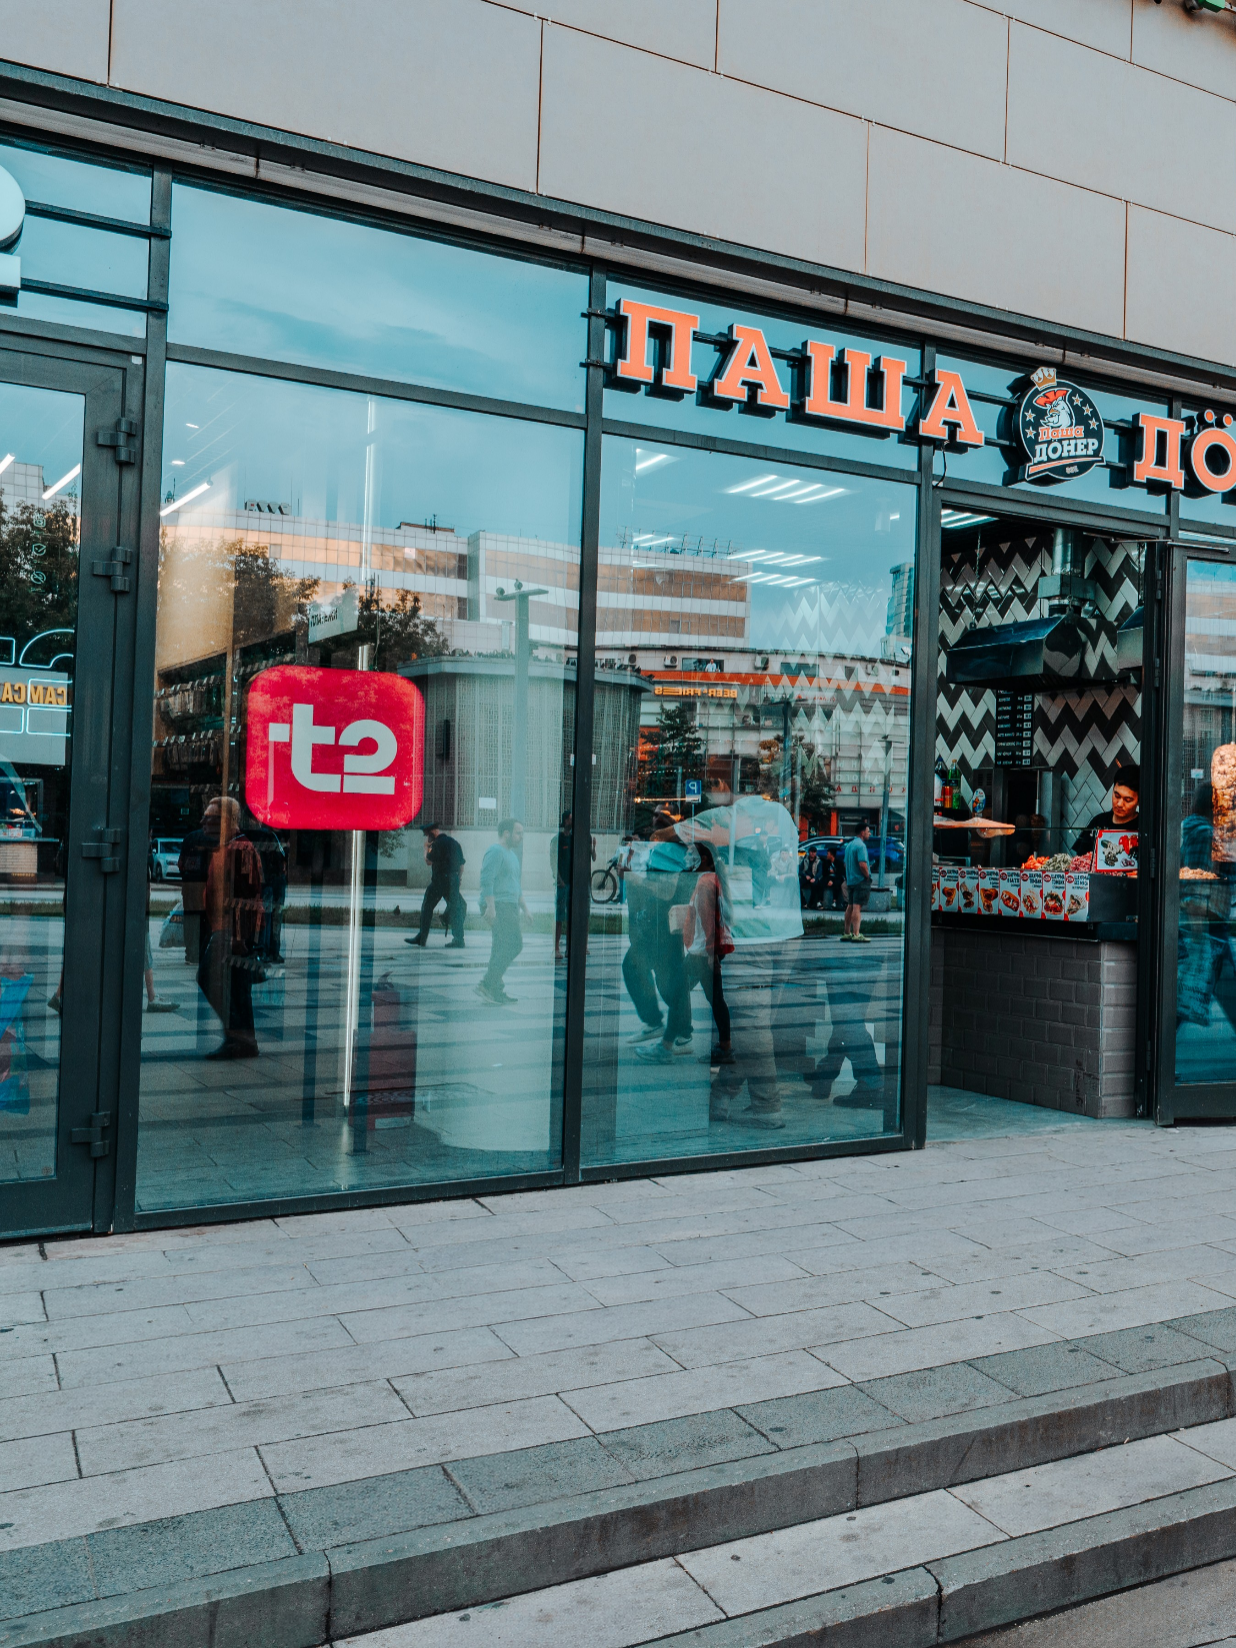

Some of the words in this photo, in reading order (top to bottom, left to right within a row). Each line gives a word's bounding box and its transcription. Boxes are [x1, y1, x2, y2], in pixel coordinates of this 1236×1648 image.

[615, 298, 985, 448] ПАША
[1038, 425, 1085, 442] Паша
[268, 703, 398, 795] t2
